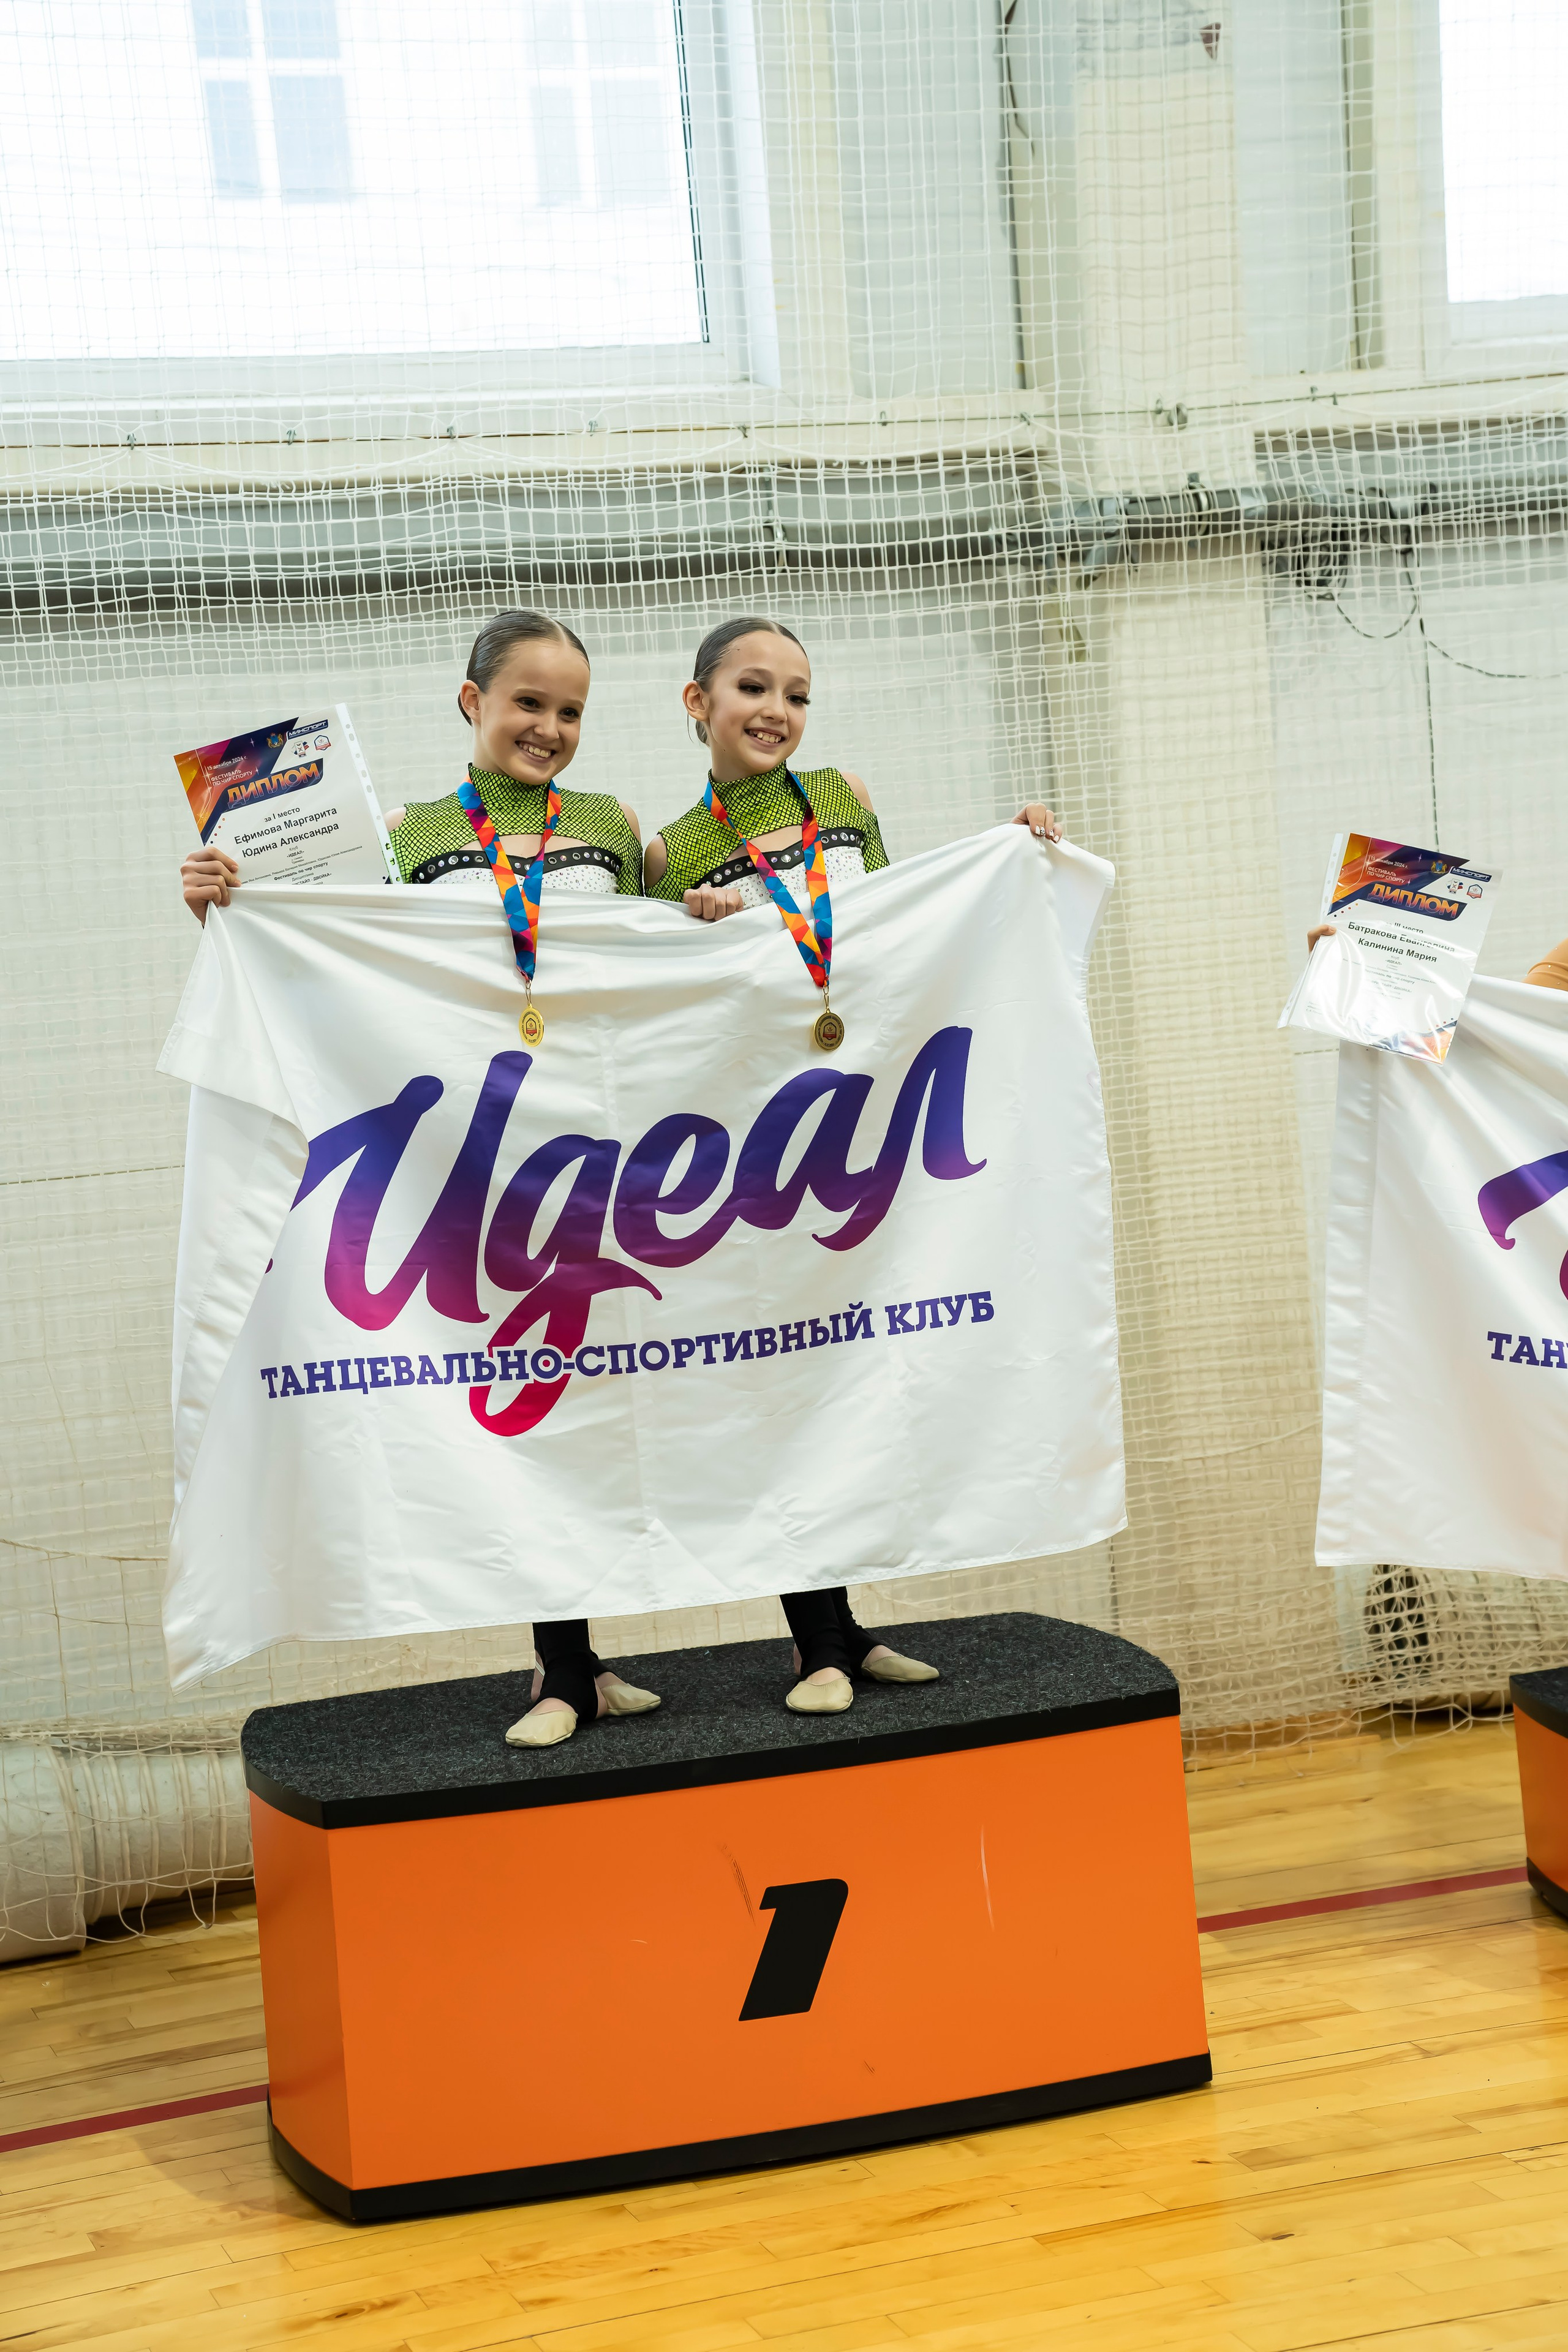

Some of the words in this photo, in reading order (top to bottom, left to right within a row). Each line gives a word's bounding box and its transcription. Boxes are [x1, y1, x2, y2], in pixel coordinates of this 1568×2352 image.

[289, 722, 326, 736] МИНСПОРТ
[211, 769, 241, 782] ФЕСТИВАЛЬ
[213, 761, 232, 769] декабря
[232, 770, 253, 780] СПОРТУ
[227, 763, 320, 809] ДИПЛОМ
[277, 807, 300, 818] место
[234, 825, 282, 844] Ефимова
[284, 808, 337, 829] Маргарита
[242, 842, 278, 858] Юдина
[280, 823, 339, 846] Александра
[274, 872, 298, 880] Фестиваль
[1368, 866, 1396, 877] ФЕСТИВАЛЬ
[1452, 868, 1490, 880] МИНСПОРТ
[1367, 883, 1459, 918] ДИПЛОМ
[1348, 921, 1397, 940] Батракова
[1358, 938, 1403, 955] Калинина
[1406, 949, 1437, 963] Мария
[266, 1025, 987, 1437] Идеал
[260, 1302, 875, 1399] ТАНЦЕВАЛЬНО-СПОРТИВНЫЙ
[884, 1291, 995, 1336] КЛУБ
[1487, 1330, 1568, 1369] ТАН
[738, 1878, 849, 2021] 1
